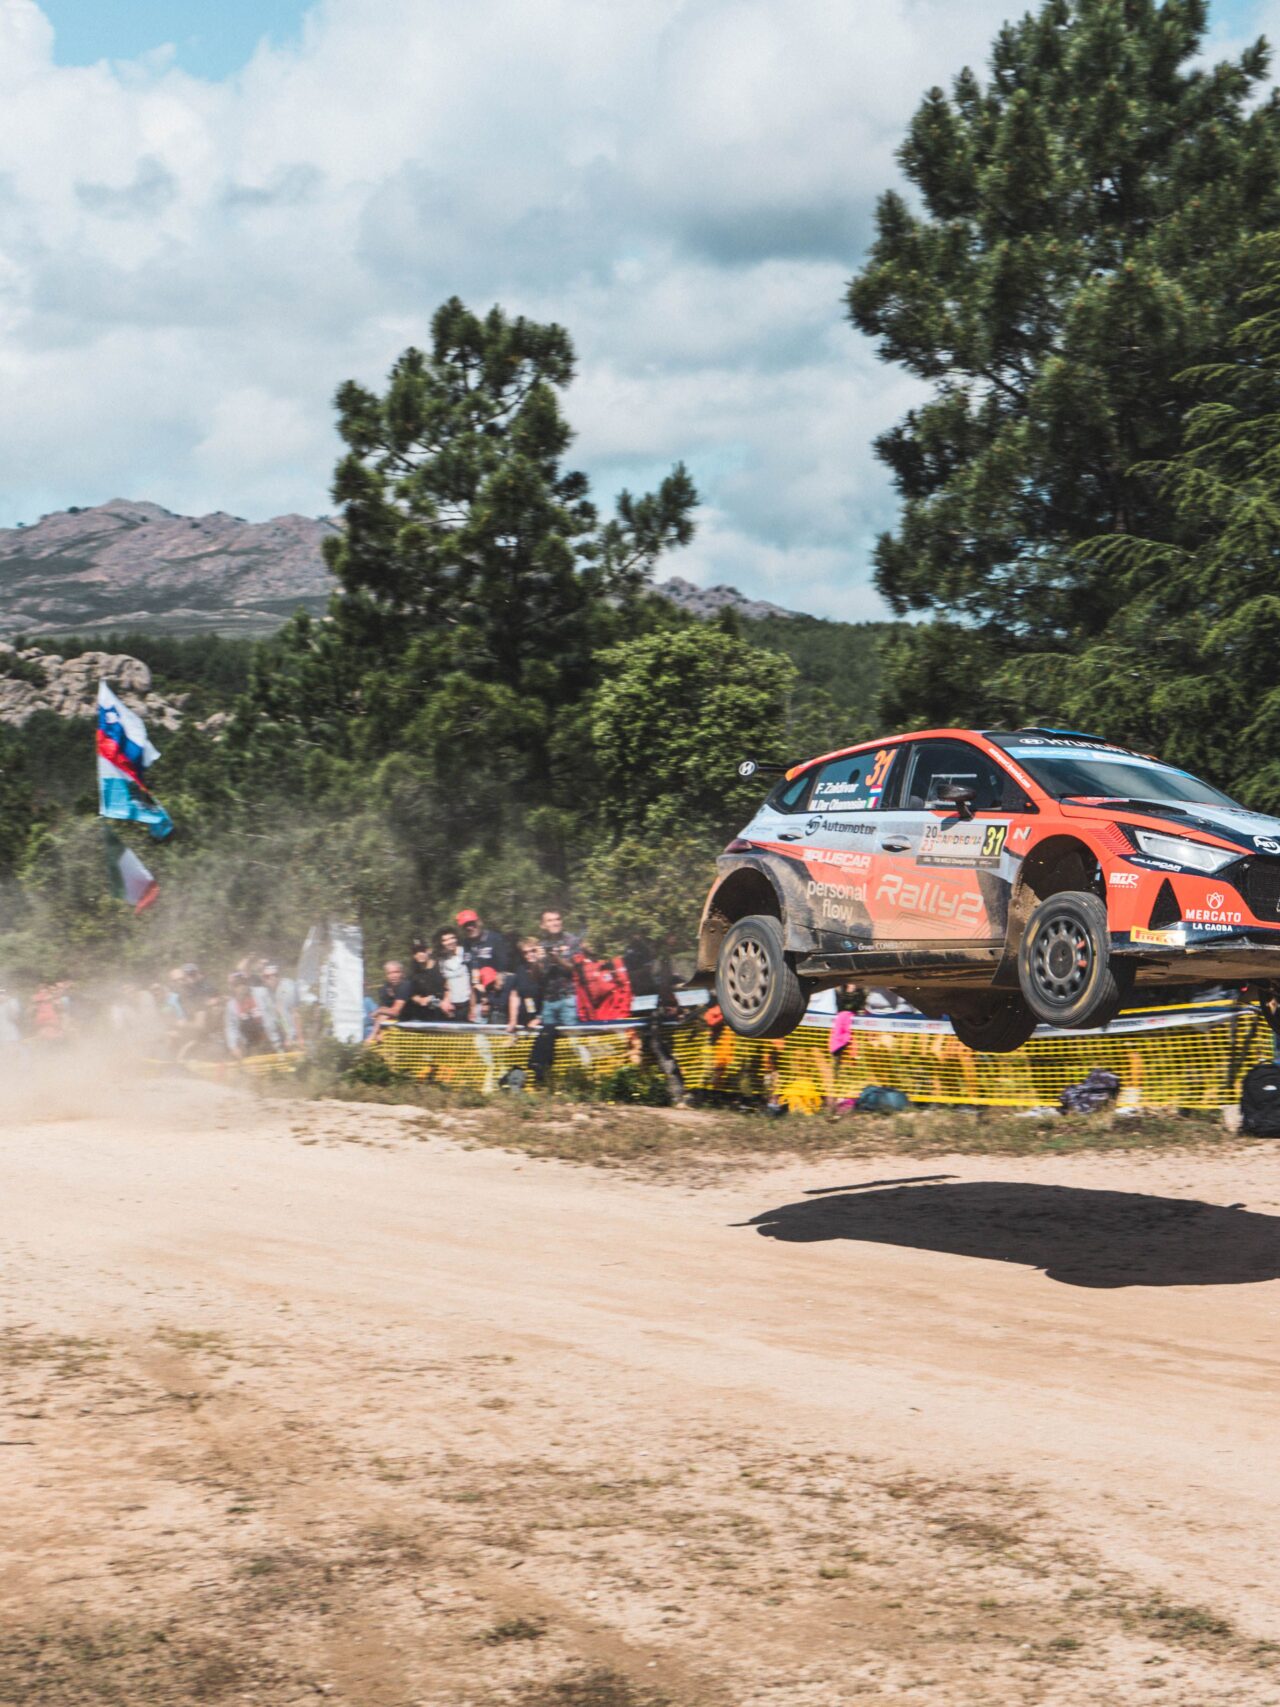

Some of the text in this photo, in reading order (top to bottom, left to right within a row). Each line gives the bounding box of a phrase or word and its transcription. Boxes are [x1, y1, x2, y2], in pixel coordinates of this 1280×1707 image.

[865, 749, 898, 786] 31
[822, 820, 877, 835] Automotor
[926, 826, 938, 838] 20
[983, 826, 1006, 856] 31
[806, 881, 867, 902] personal
[875, 874, 984, 924] Rally2
[822, 899, 853, 920] flow
[1186, 909, 1242, 923] MERCATO
